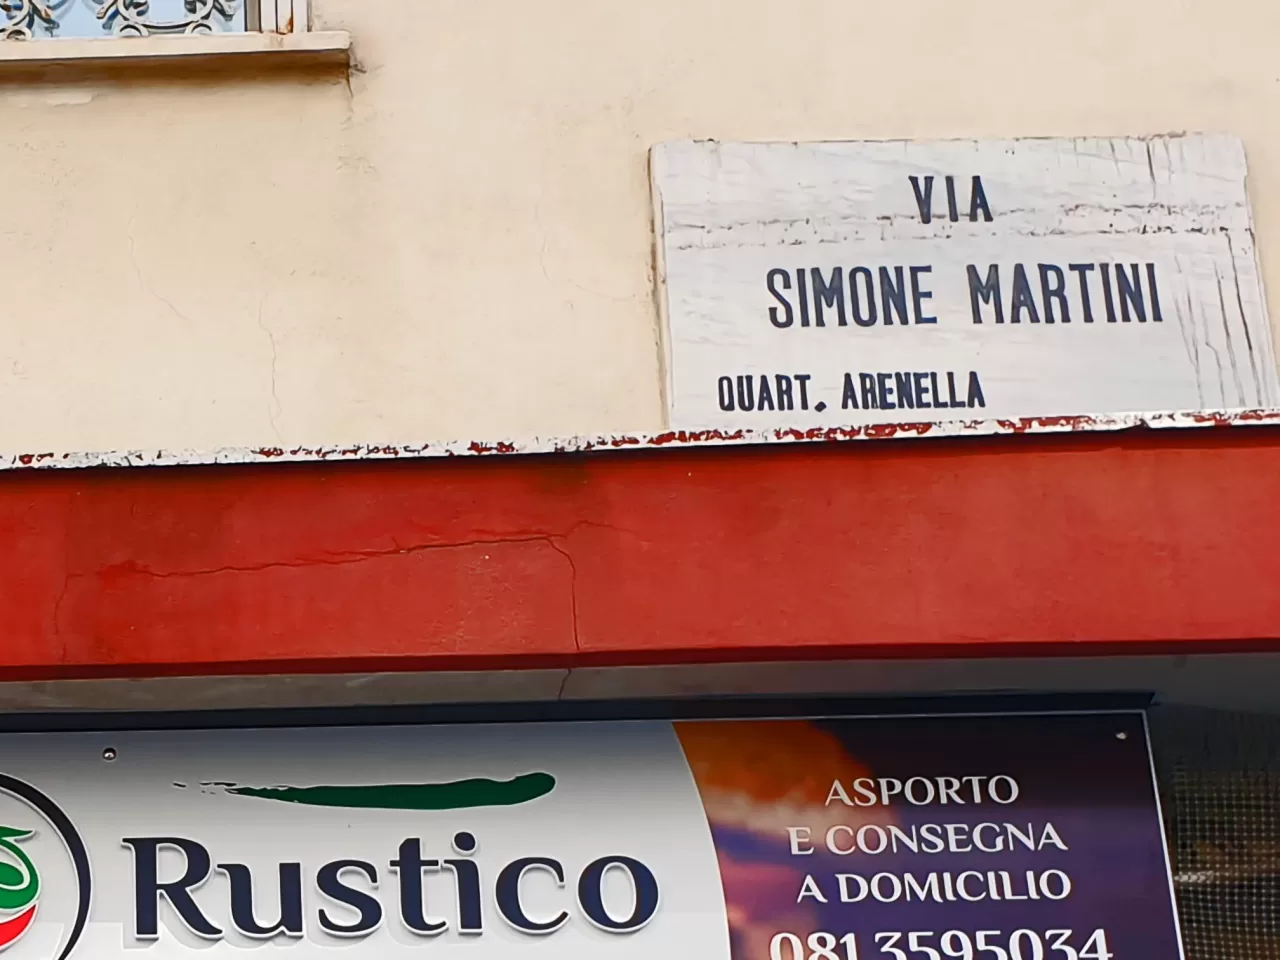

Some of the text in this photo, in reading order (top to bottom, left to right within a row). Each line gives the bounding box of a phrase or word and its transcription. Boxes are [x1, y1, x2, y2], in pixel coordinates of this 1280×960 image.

[909, 174, 994, 225] VIA
[767, 262, 1163, 328] SIMONE MARTINI
[717, 370, 987, 412] QUART. ARENELLA
[824, 774, 1020, 807] ASPORTO
[785, 821, 1068, 855] E CONSEGNA
[121, 831, 660, 940] Rustico
[796, 869, 1072, 904] A DOMICILIO
